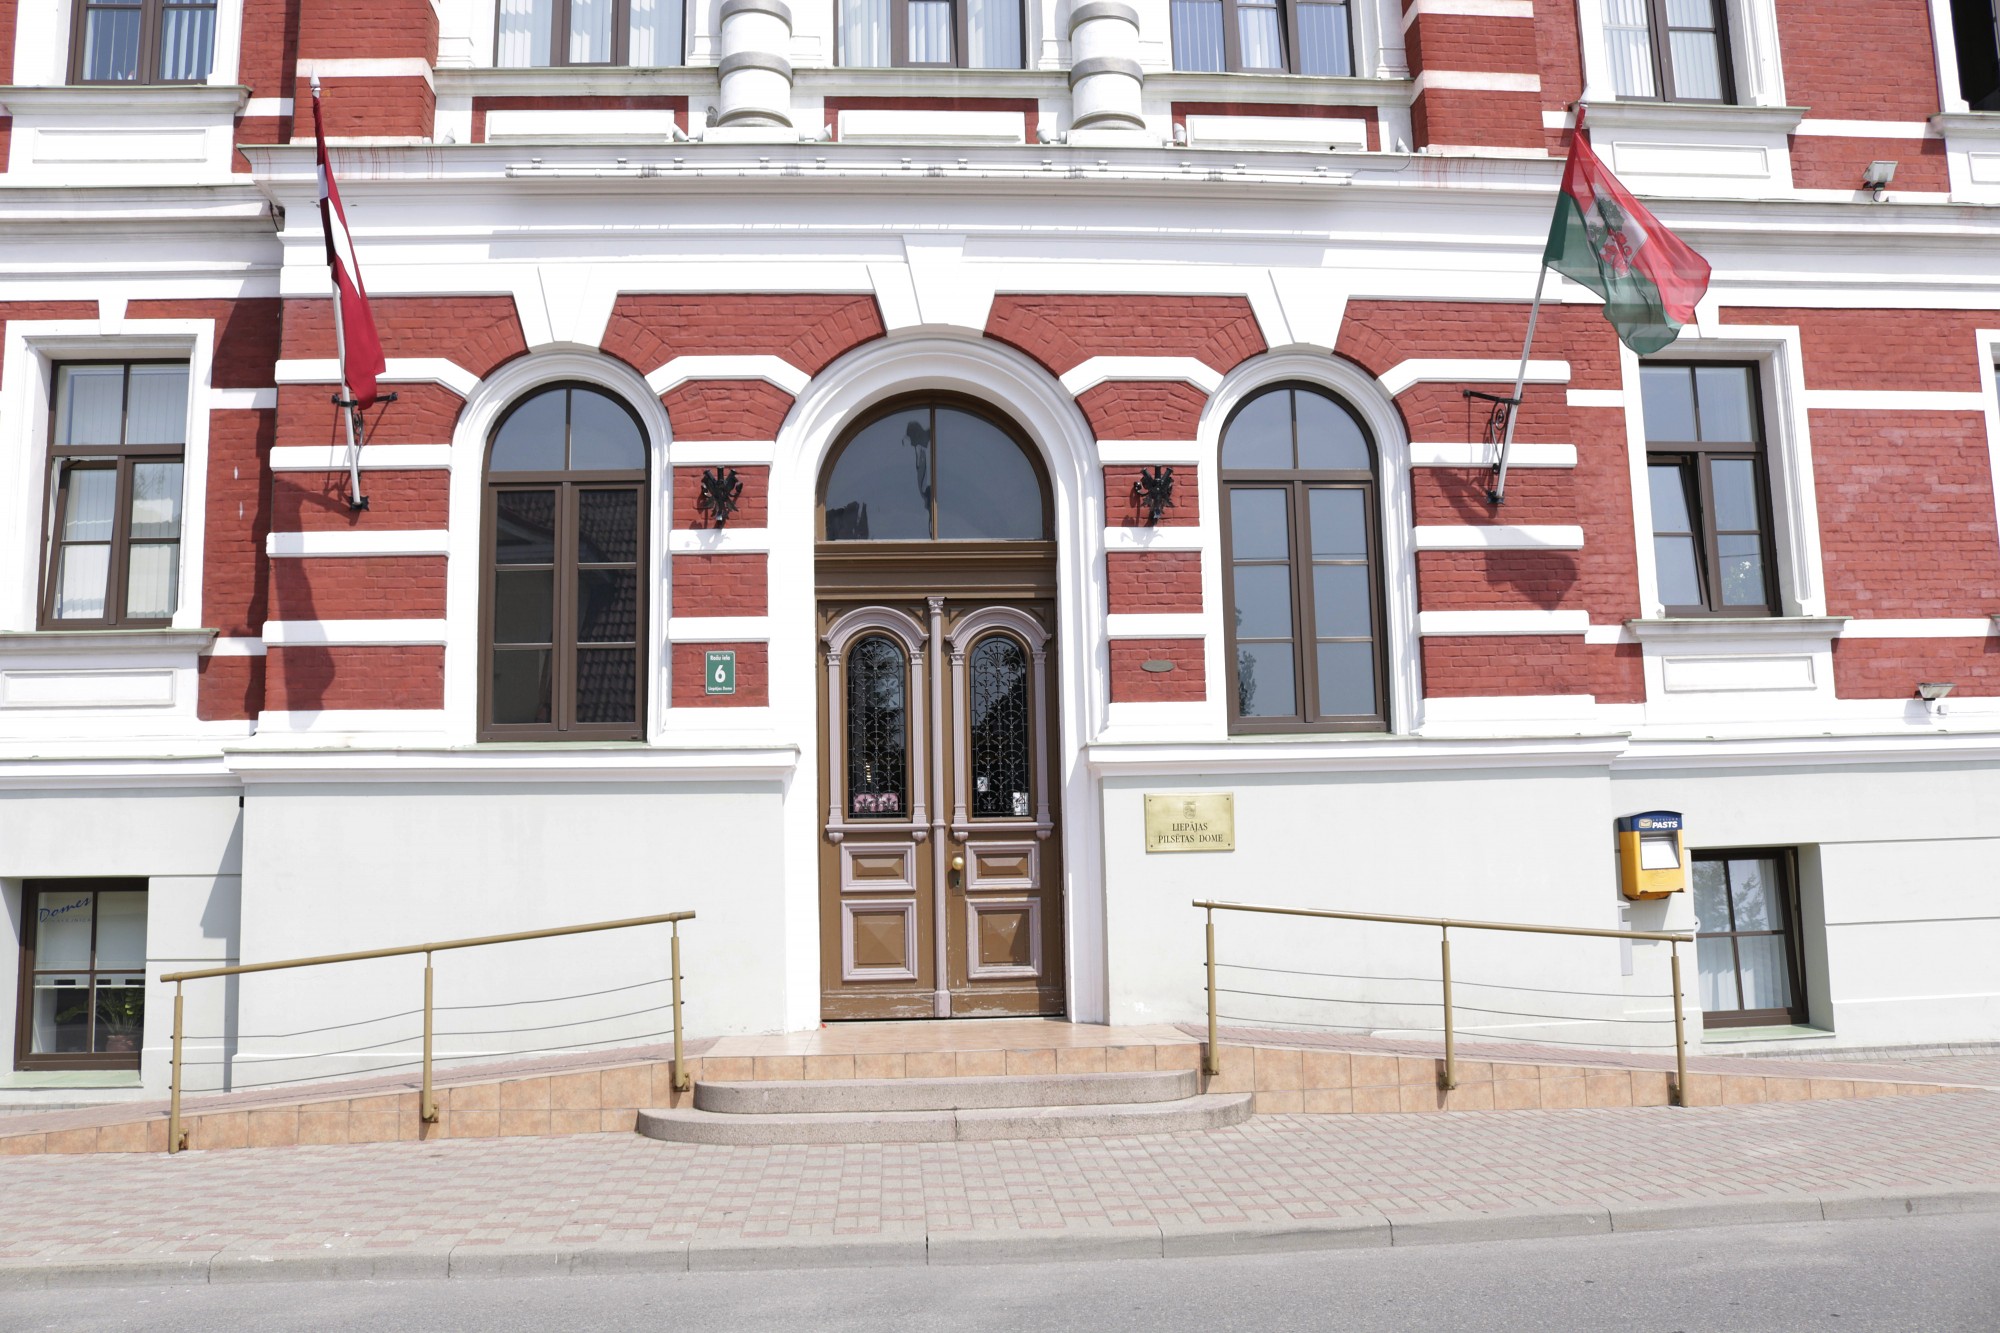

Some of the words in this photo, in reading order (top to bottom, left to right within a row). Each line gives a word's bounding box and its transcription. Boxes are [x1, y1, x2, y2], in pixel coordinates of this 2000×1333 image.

[714, 664, 726, 683] 6
[1172, 821, 1208, 832] LIEPĀJAS
[1652, 821, 1678, 829] PASTS
[1158, 833, 1195, 844] PILSĒTAS
[1199, 833, 1223, 843] DOME
[39, 897, 91, 923] Domes
